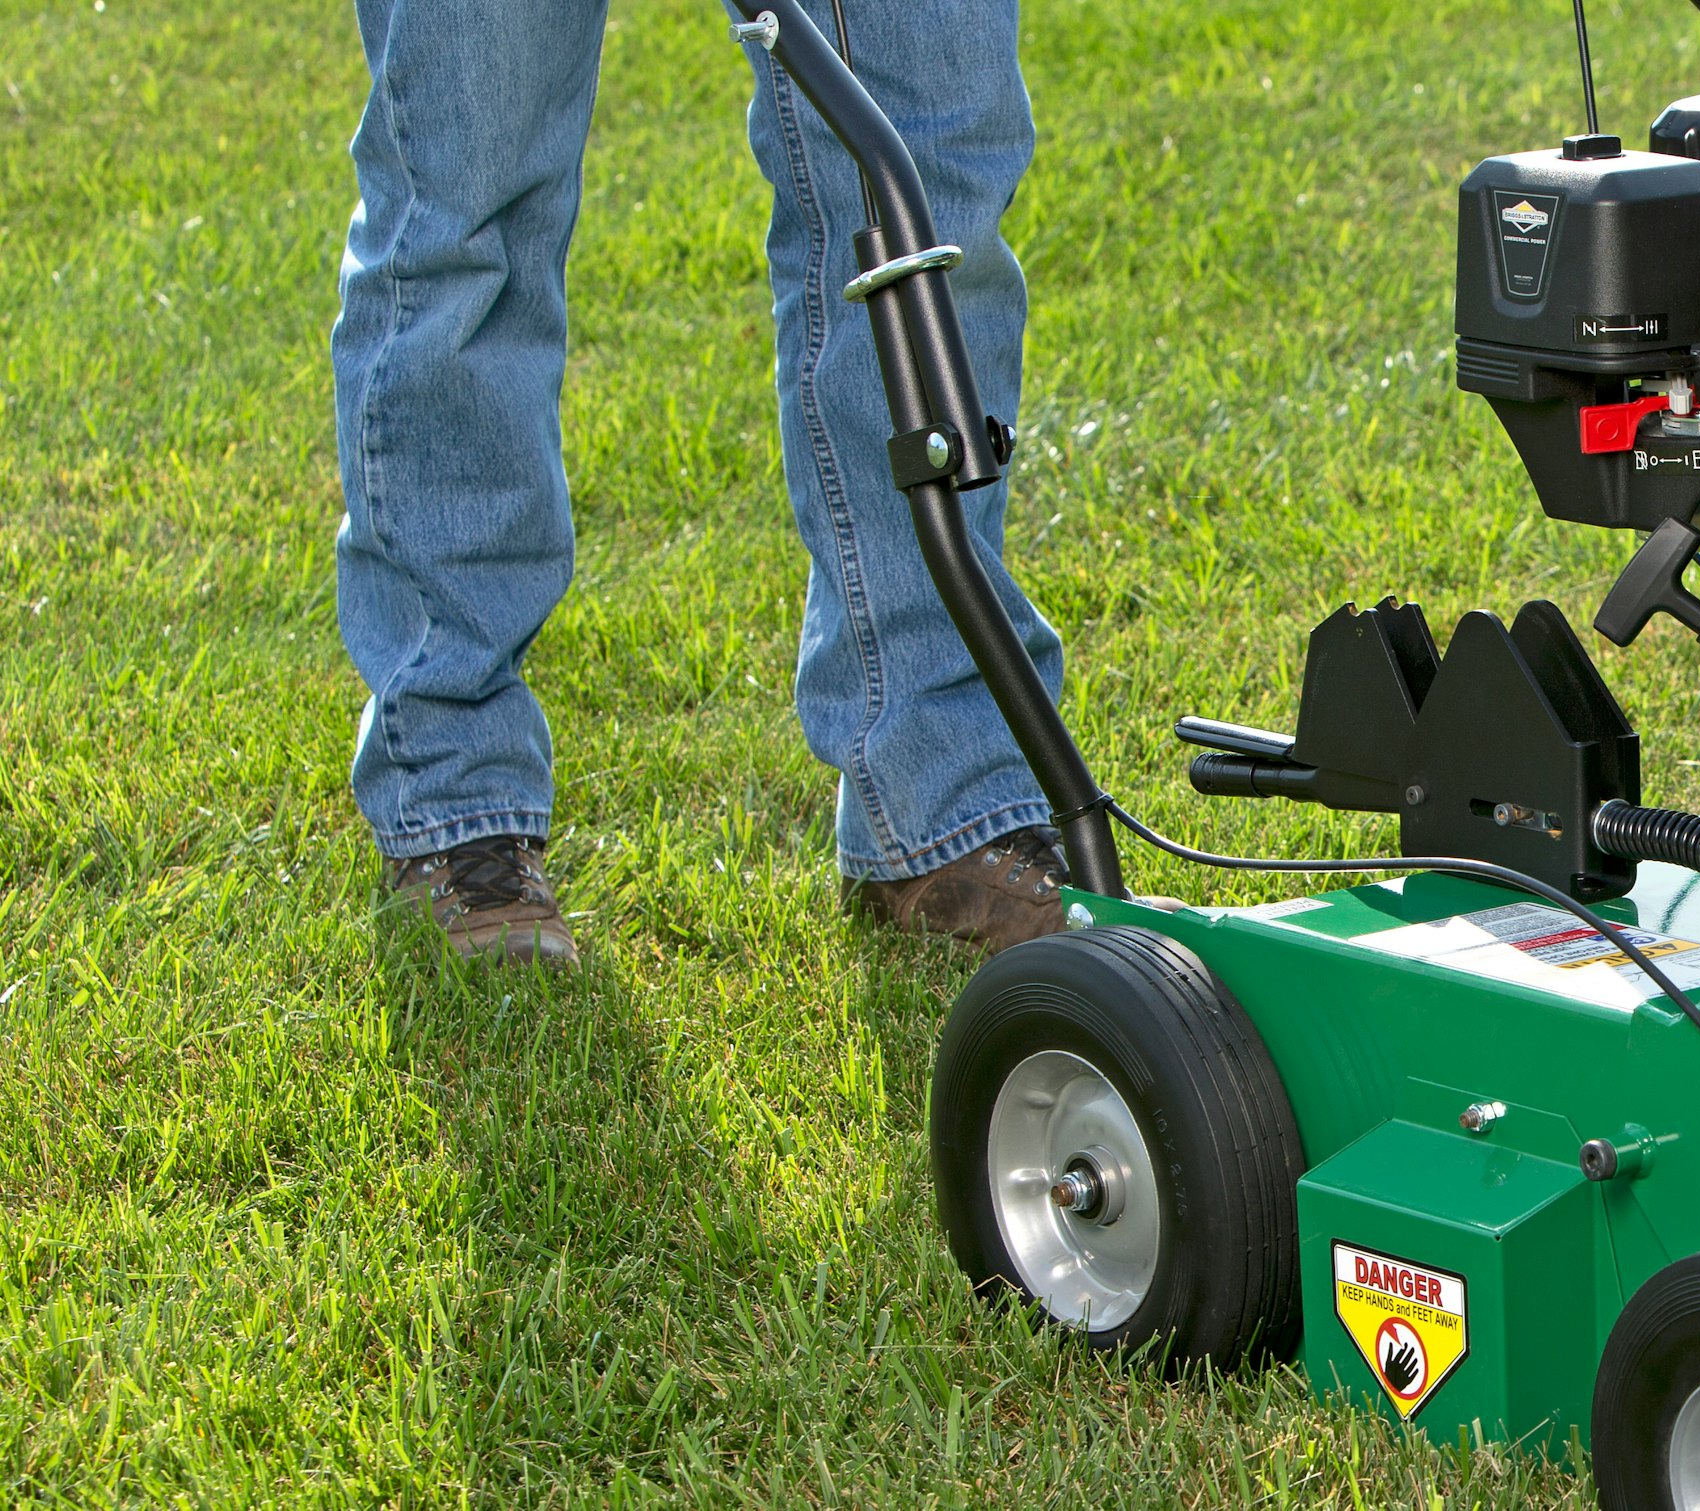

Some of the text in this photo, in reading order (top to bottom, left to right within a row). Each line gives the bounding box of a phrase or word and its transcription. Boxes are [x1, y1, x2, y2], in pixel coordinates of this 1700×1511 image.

[1355, 1255, 1443, 1308] DANGER
[1342, 1284, 1459, 1331] KEEP HANDS and FEET AWAY
